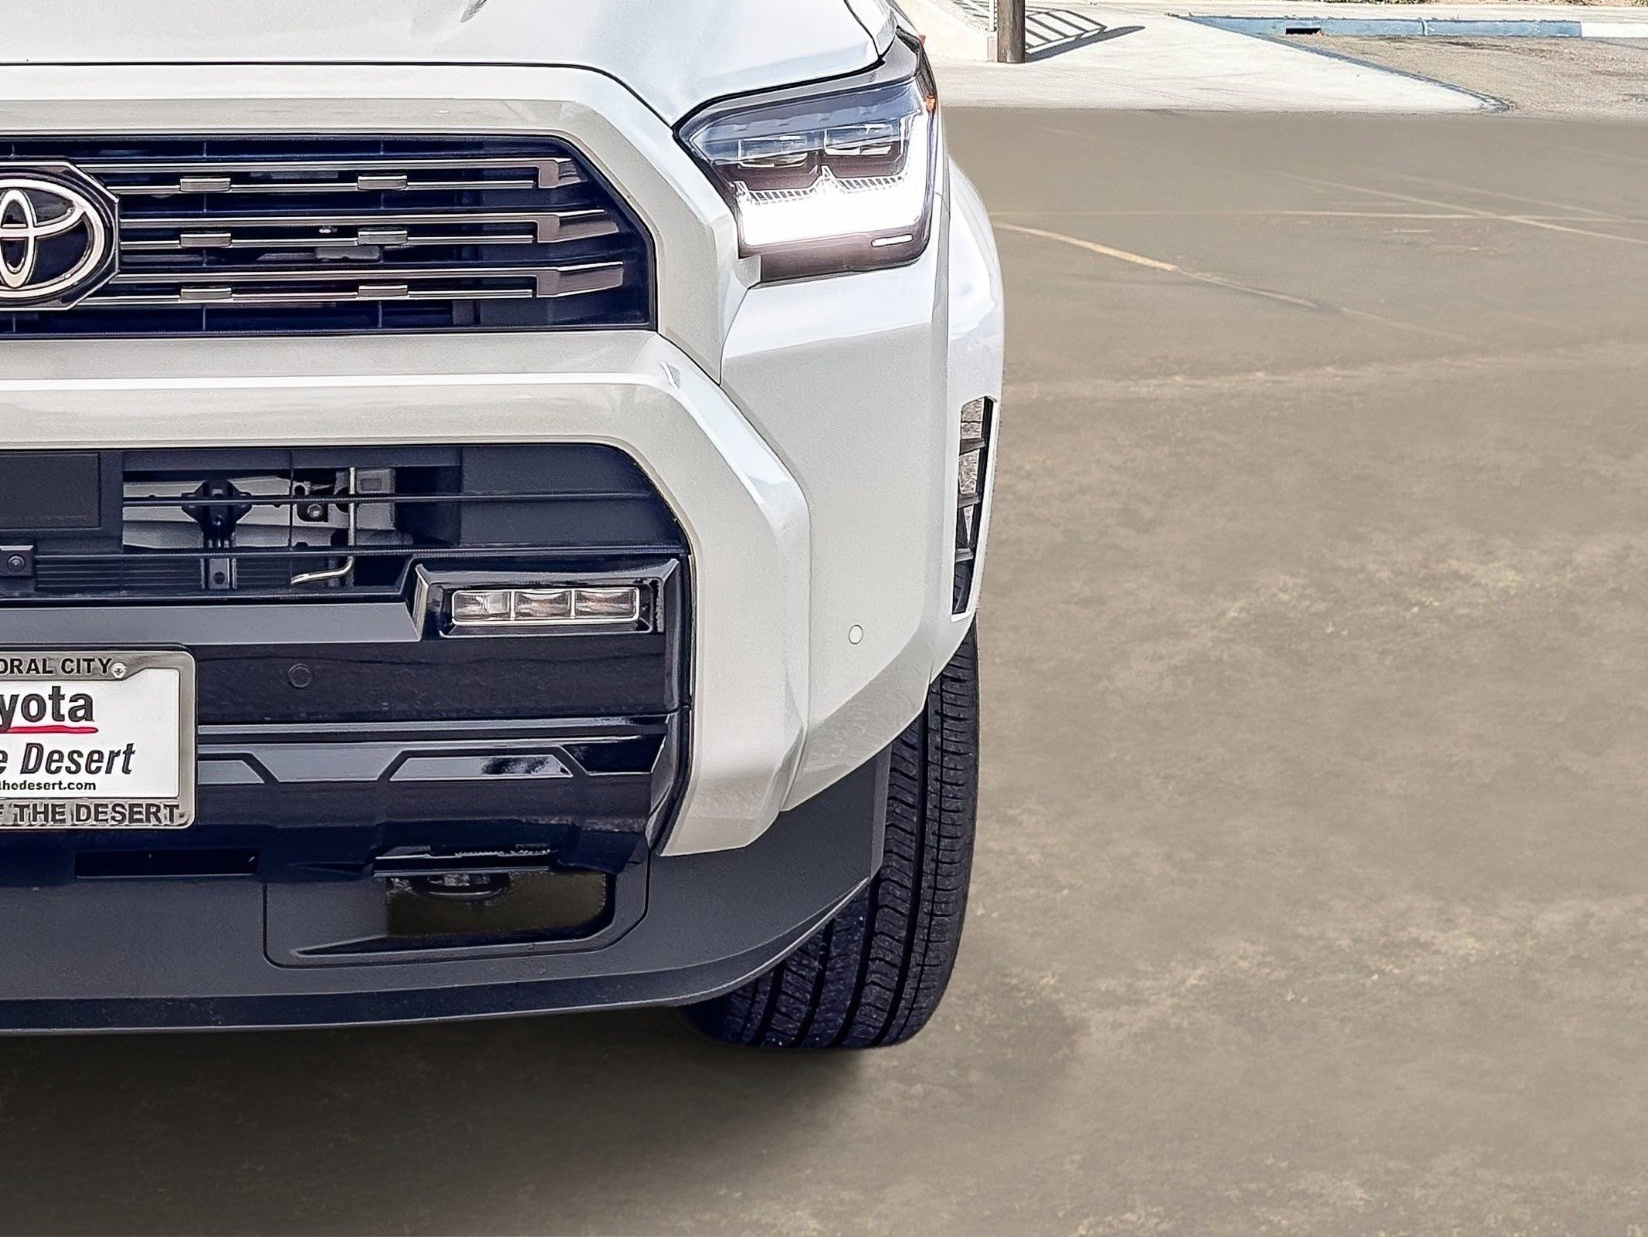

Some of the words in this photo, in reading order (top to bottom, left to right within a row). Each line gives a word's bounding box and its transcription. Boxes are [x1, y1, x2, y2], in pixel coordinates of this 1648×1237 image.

[60, 658, 112, 674] CITY
[19, 743, 136, 775] Desert
[12, 803, 66, 824] THE
[74, 803, 180, 825] DESERT
